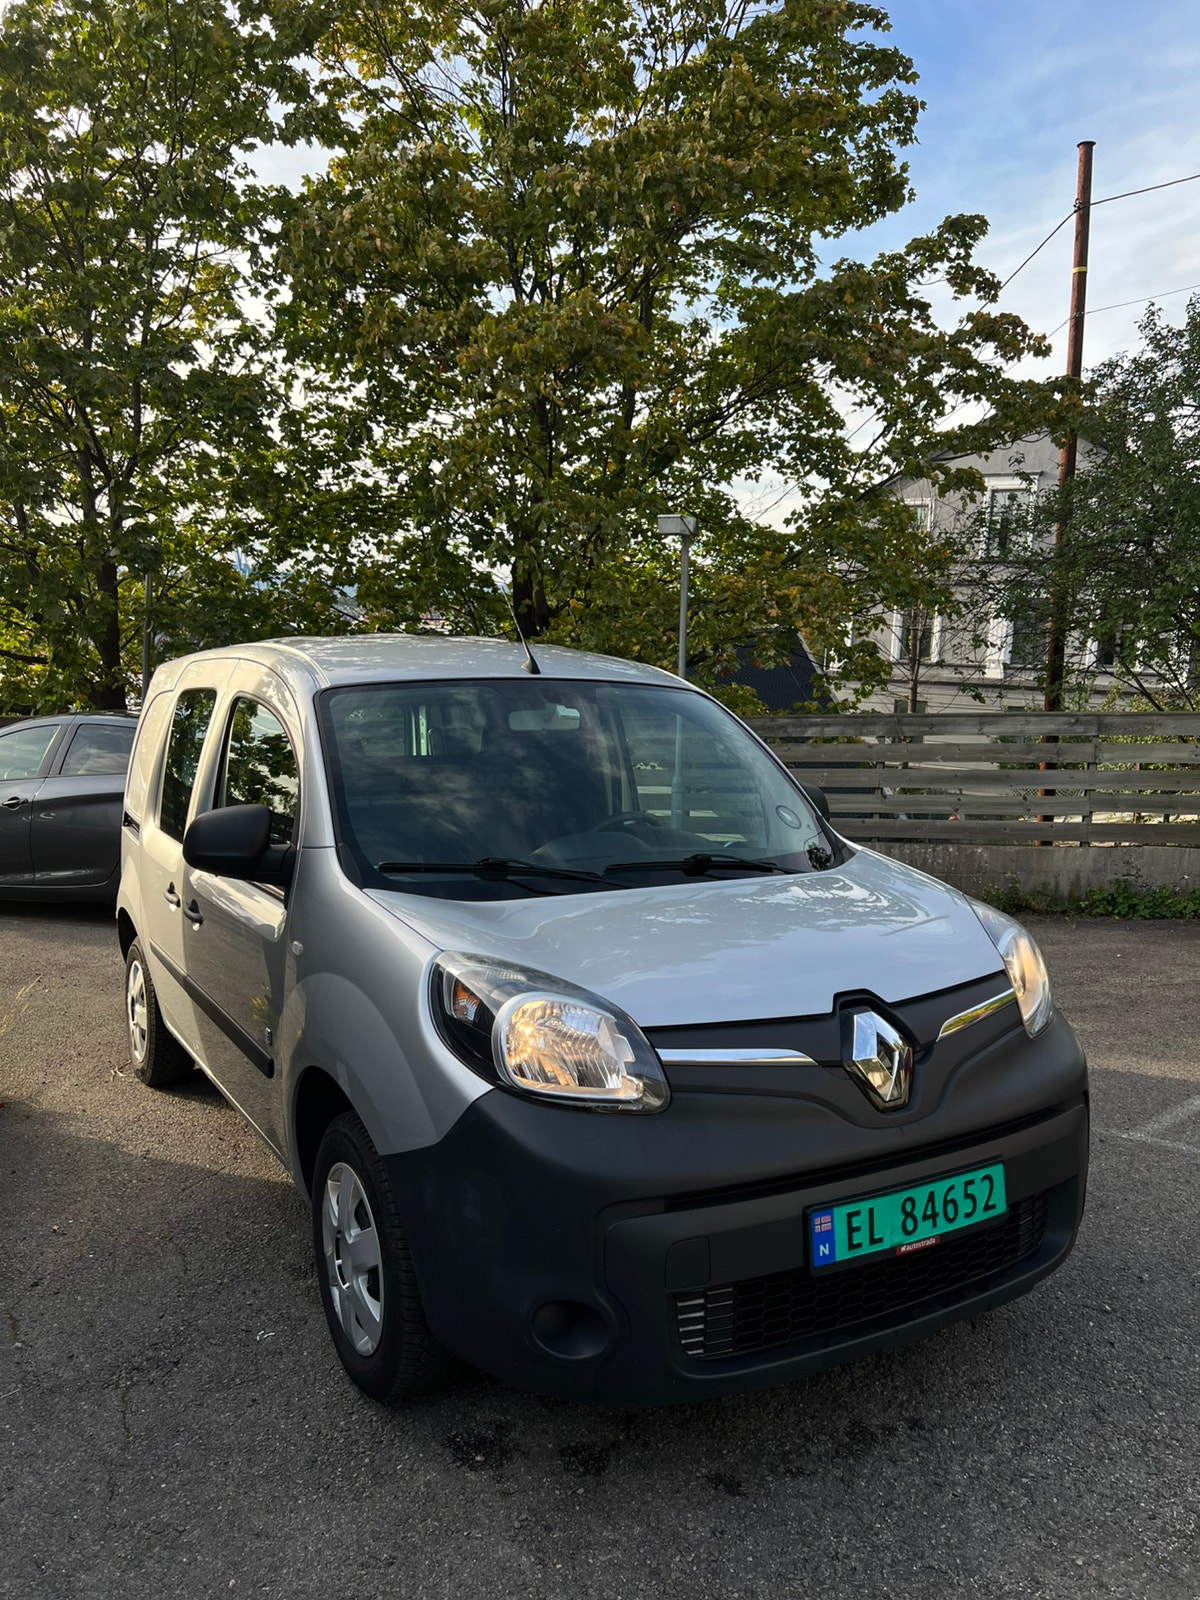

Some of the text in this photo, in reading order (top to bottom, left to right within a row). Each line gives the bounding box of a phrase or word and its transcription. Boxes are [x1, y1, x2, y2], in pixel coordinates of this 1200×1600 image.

[846, 1174, 997, 1252] EL 84652
[819, 1243, 830, 1256] N
